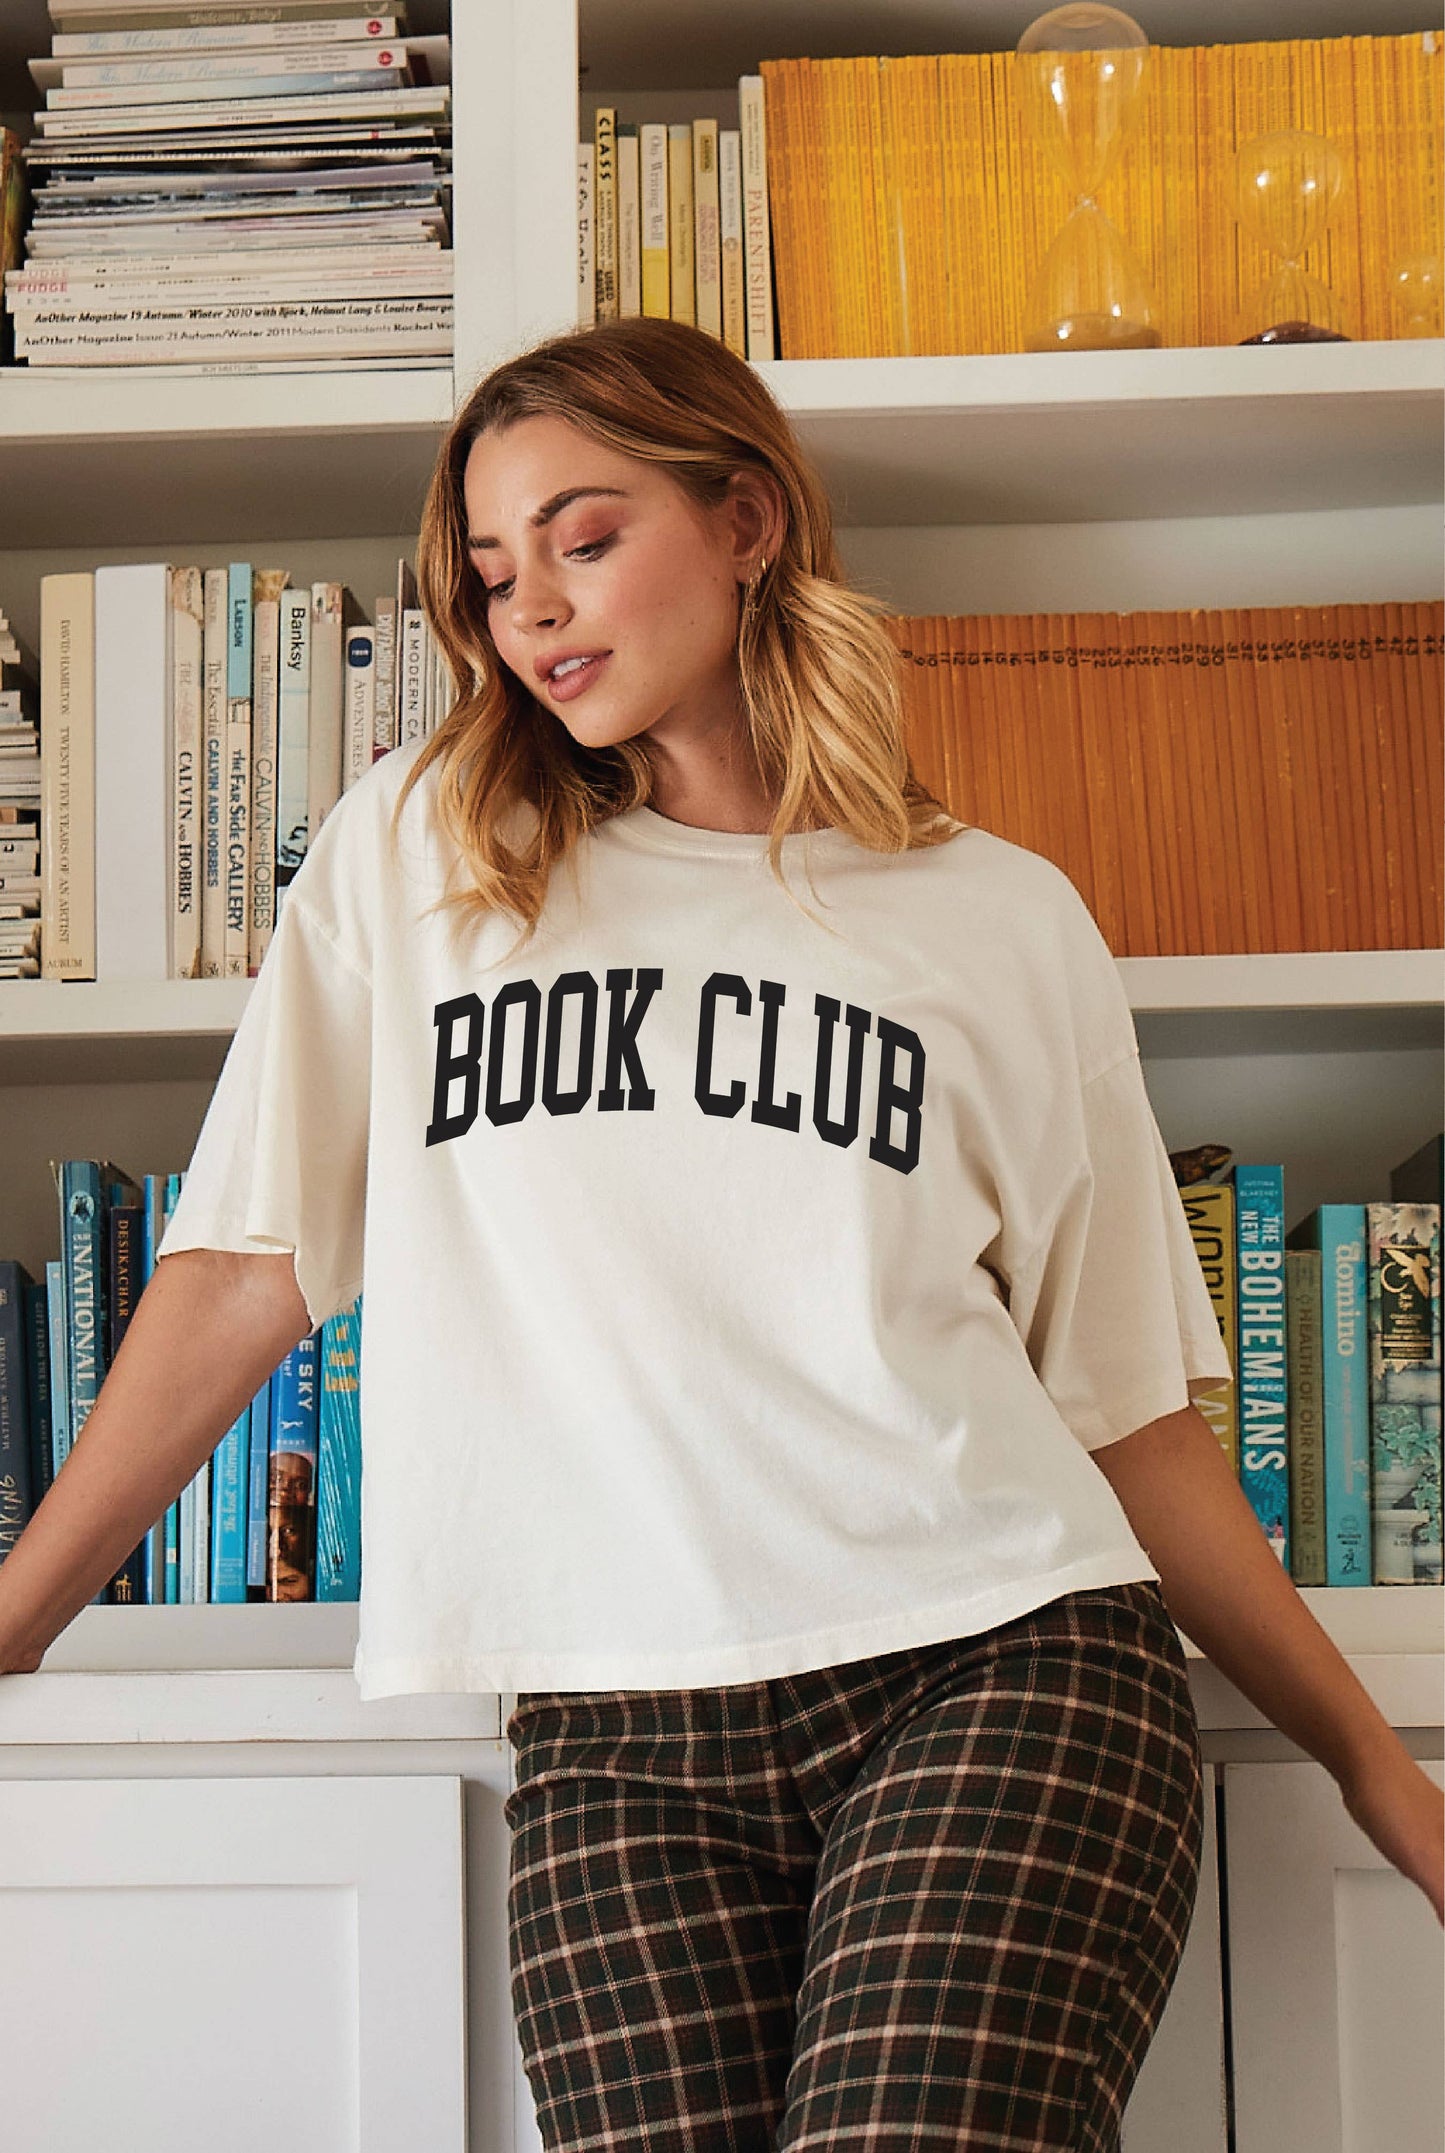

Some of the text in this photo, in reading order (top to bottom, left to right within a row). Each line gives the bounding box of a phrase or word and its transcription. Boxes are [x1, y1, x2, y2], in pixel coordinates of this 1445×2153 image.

[599, 116, 612, 181] CLASS
[648, 135, 664, 241] On Writing Well
[17, 281, 68, 293] FUDGE
[604, 271, 614, 301] USED
[747, 190, 767, 337] PARENTSHIFT
[24, 335, 72, 346] AnOther
[77, 333, 134, 346] Magazine
[265, 327, 291, 337] 2011
[393, 321, 433, 332] Rachel
[34, 312, 76, 323] AnOther
[78, 311, 128, 324] Magazine
[225, 308, 252, 319] 2010
[253, 306, 277, 318] with
[310, 305, 346, 316] Helmut
[347, 304, 373, 317] Lang
[383, 302, 415, 314] Louise
[208, 660, 222, 684] The
[260, 654, 271, 673] THE
[288, 607, 306, 671] Banksy
[1211, 644, 1224, 666] 30
[407, 639, 420, 711] MODERN
[353, 679, 367, 768] ADVENTURES
[58, 620, 70, 944] DAVID HAMILTON TWENTY FIVE YEARS OF AN ARTIST
[178, 751, 192, 821] CALVIN
[206, 739, 220, 790] CALVIN
[255, 757, 273, 831] CALVIN
[206, 795, 219, 825] AND
[178, 844, 193, 914] HOBBES
[207, 828, 219, 887] HOBBES
[227, 844, 246, 933] GALLERY
[253, 852, 272, 930] HOBBES
[47, 959, 83, 968] AURUM
[426, 968, 926, 1176] BOOK CLUB
[1240, 1211, 1259, 1244] NEW
[1262, 1215, 1280, 1244] THE
[117, 1219, 130, 1317] DESIKACHAR
[1335, 1242, 1360, 1356] domino
[73, 1242, 96, 1385] NATIONAL
[298, 1363, 314, 1412] SKY
[1239, 1251, 1286, 1473] BOHEMIANS
[1299, 1309, 1316, 1526] HEALTH OF OUR NATION
